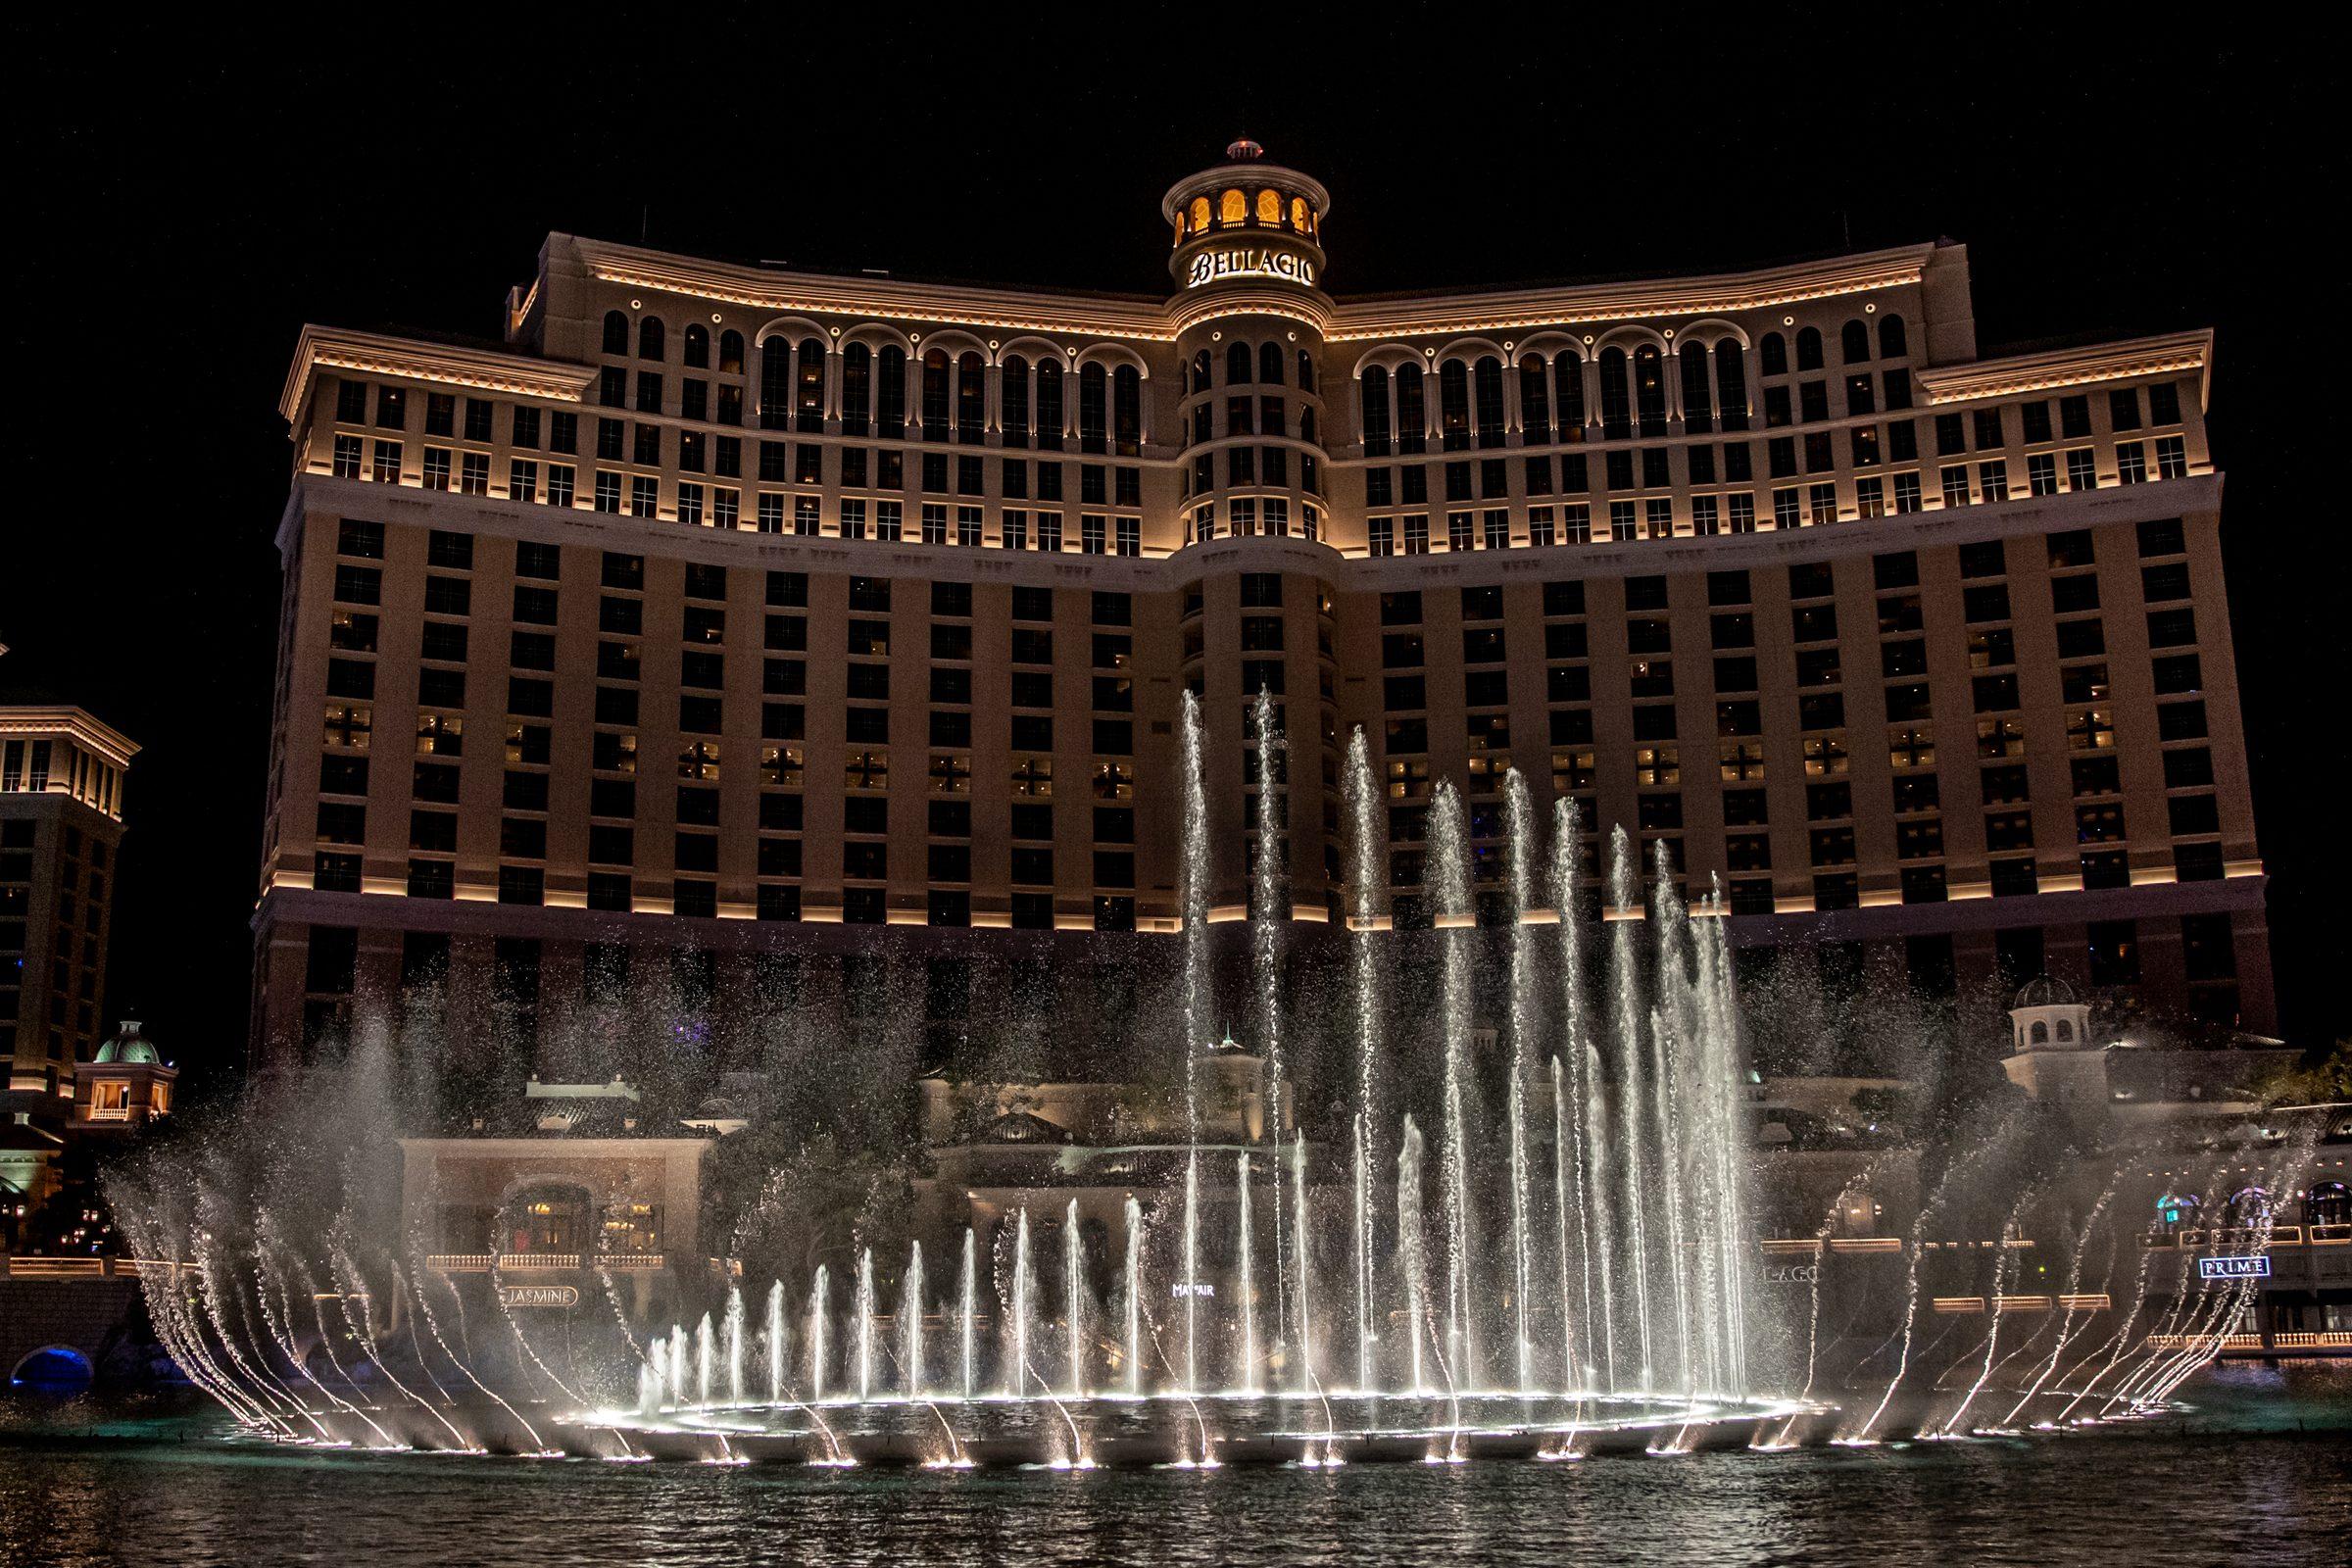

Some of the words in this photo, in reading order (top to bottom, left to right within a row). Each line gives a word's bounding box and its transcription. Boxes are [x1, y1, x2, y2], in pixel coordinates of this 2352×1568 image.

[1187, 249, 1317, 286] BELLAGIO
[2205, 1259, 2263, 1275] PRIME
[509, 1289, 569, 1303] JASMINE
